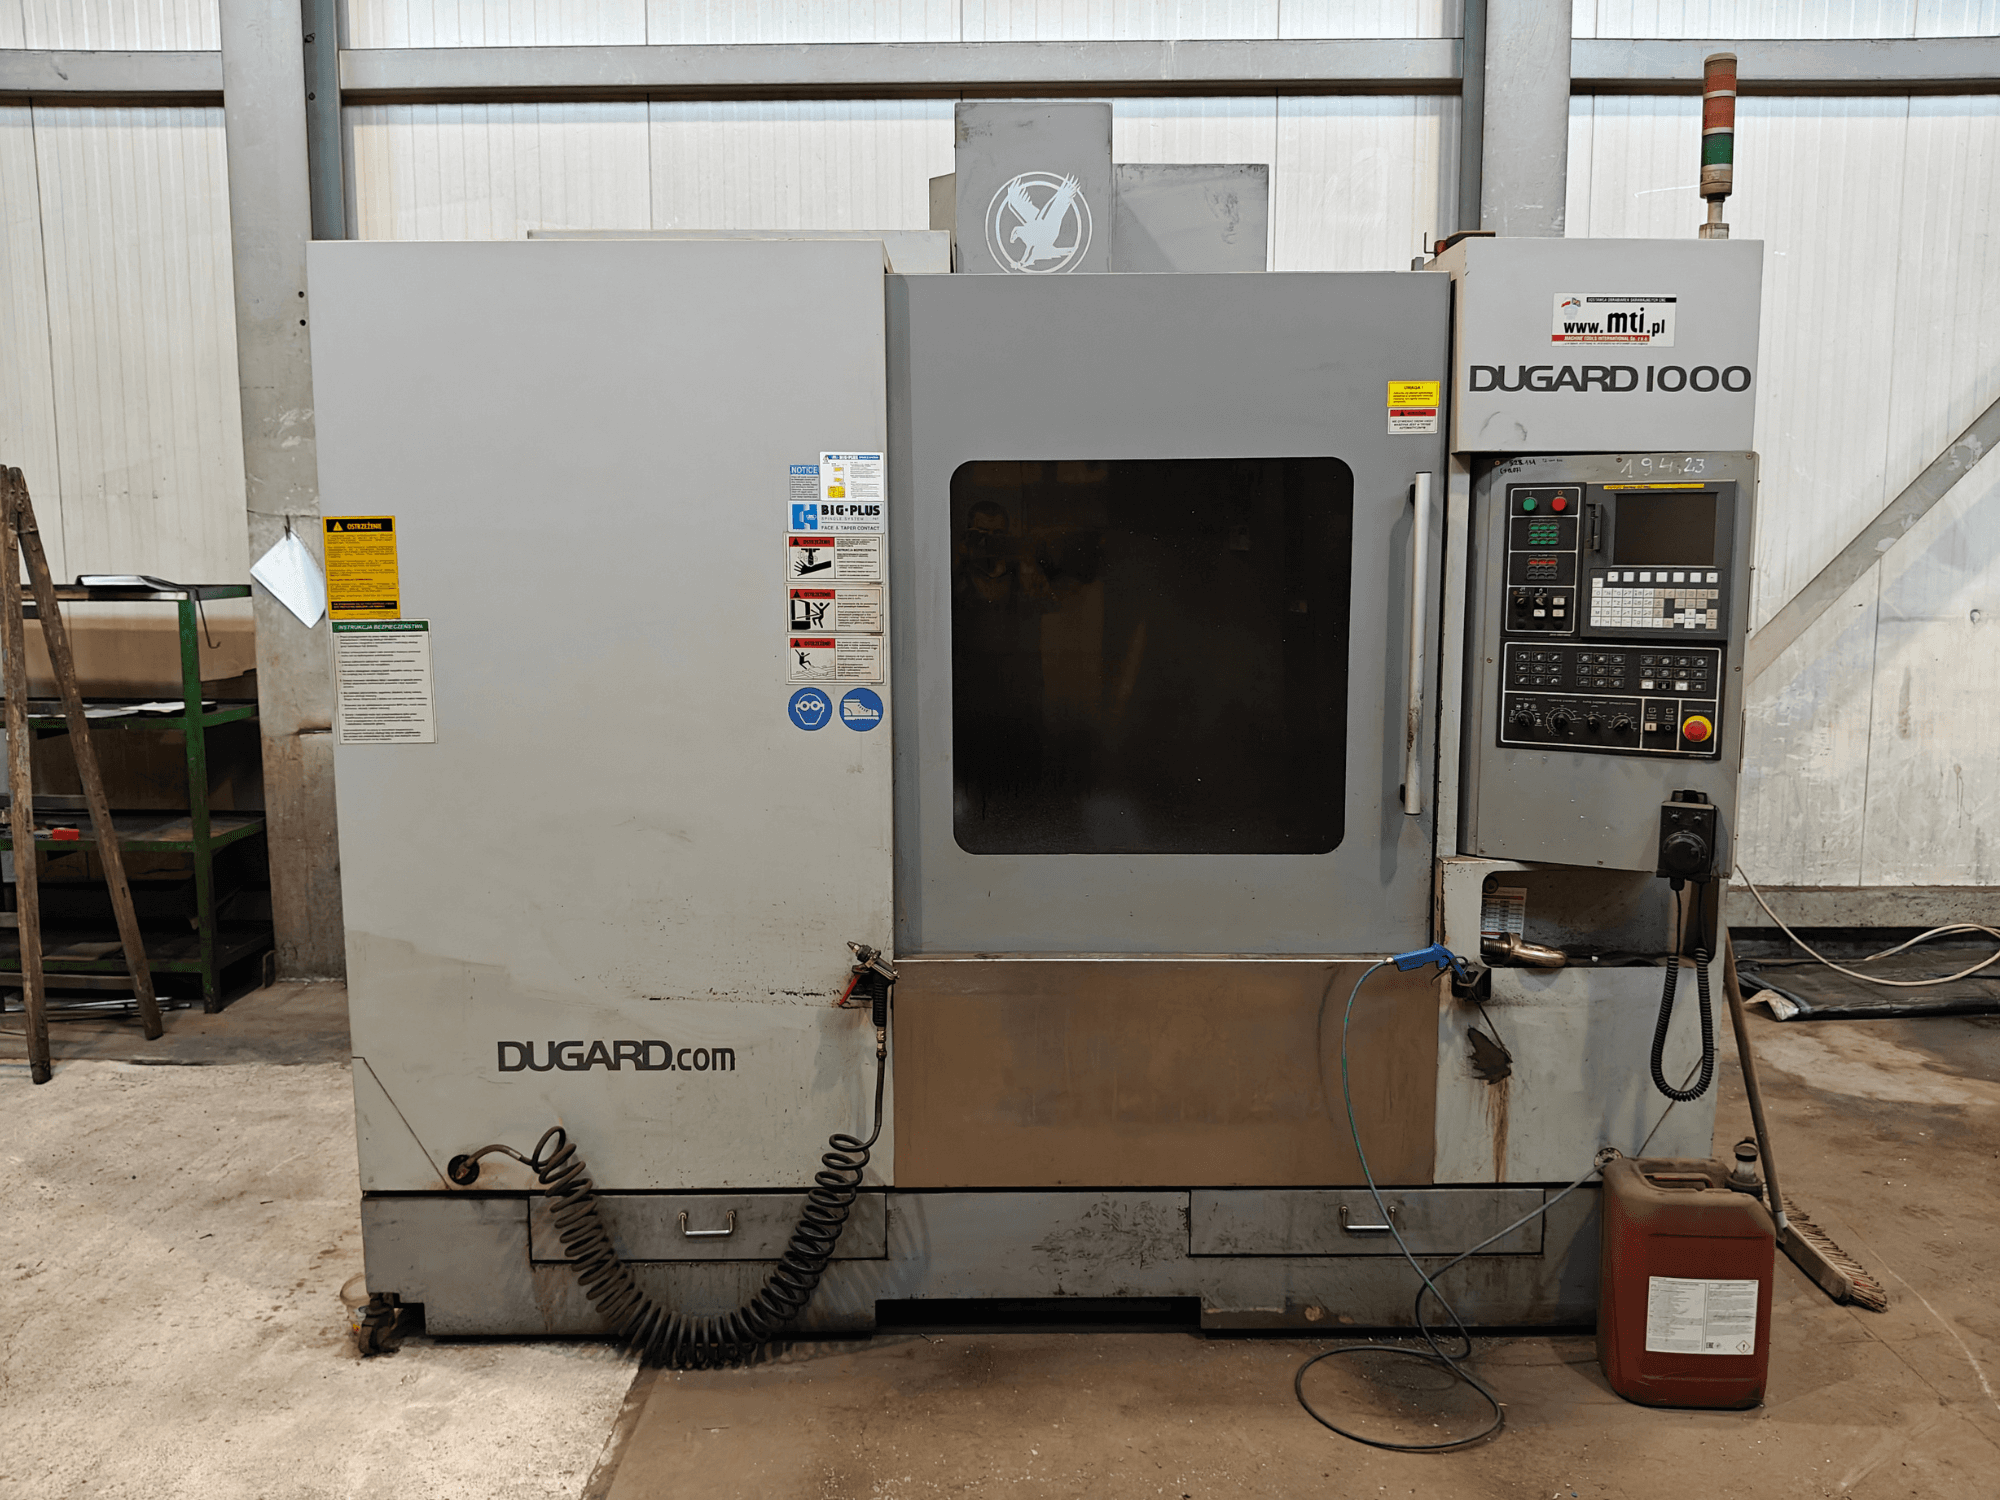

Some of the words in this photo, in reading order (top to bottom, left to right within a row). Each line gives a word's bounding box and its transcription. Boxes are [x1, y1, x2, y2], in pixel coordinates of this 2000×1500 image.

[1563, 307, 1665, 337] www.mti.pl
[1469, 365, 1638, 393] DUGARD
[1646, 365, 1752, 393] 1000
[791, 466, 818, 474] NOTICE
[497, 1040, 736, 1072] DUGARD.com
